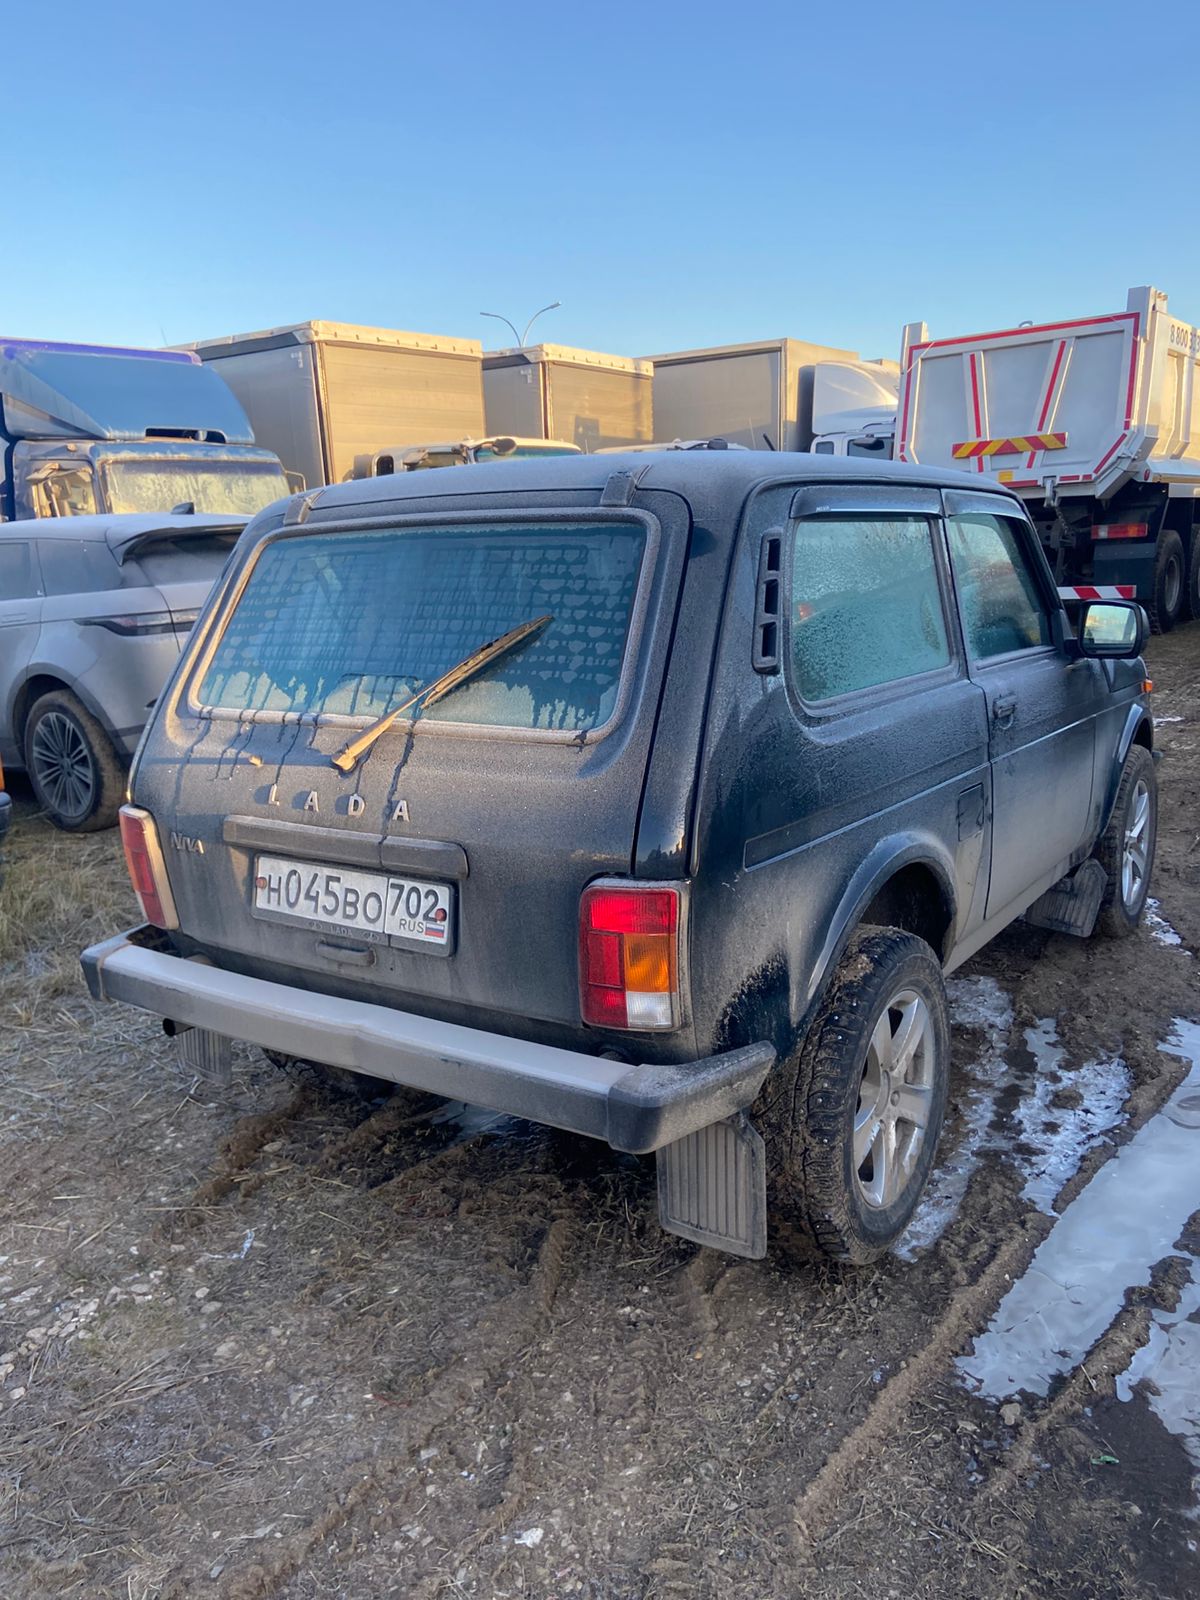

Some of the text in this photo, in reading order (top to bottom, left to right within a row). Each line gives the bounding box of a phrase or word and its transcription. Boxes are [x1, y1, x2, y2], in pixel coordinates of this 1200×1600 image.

[1170, 324, 1175, 343] 8
[1176, 326, 1188, 348] 800
[268, 784, 410, 822] LADA
[170, 831, 204, 854] NIVA
[389, 882, 440, 923] 702
[399, 918, 424, 934] RUS
